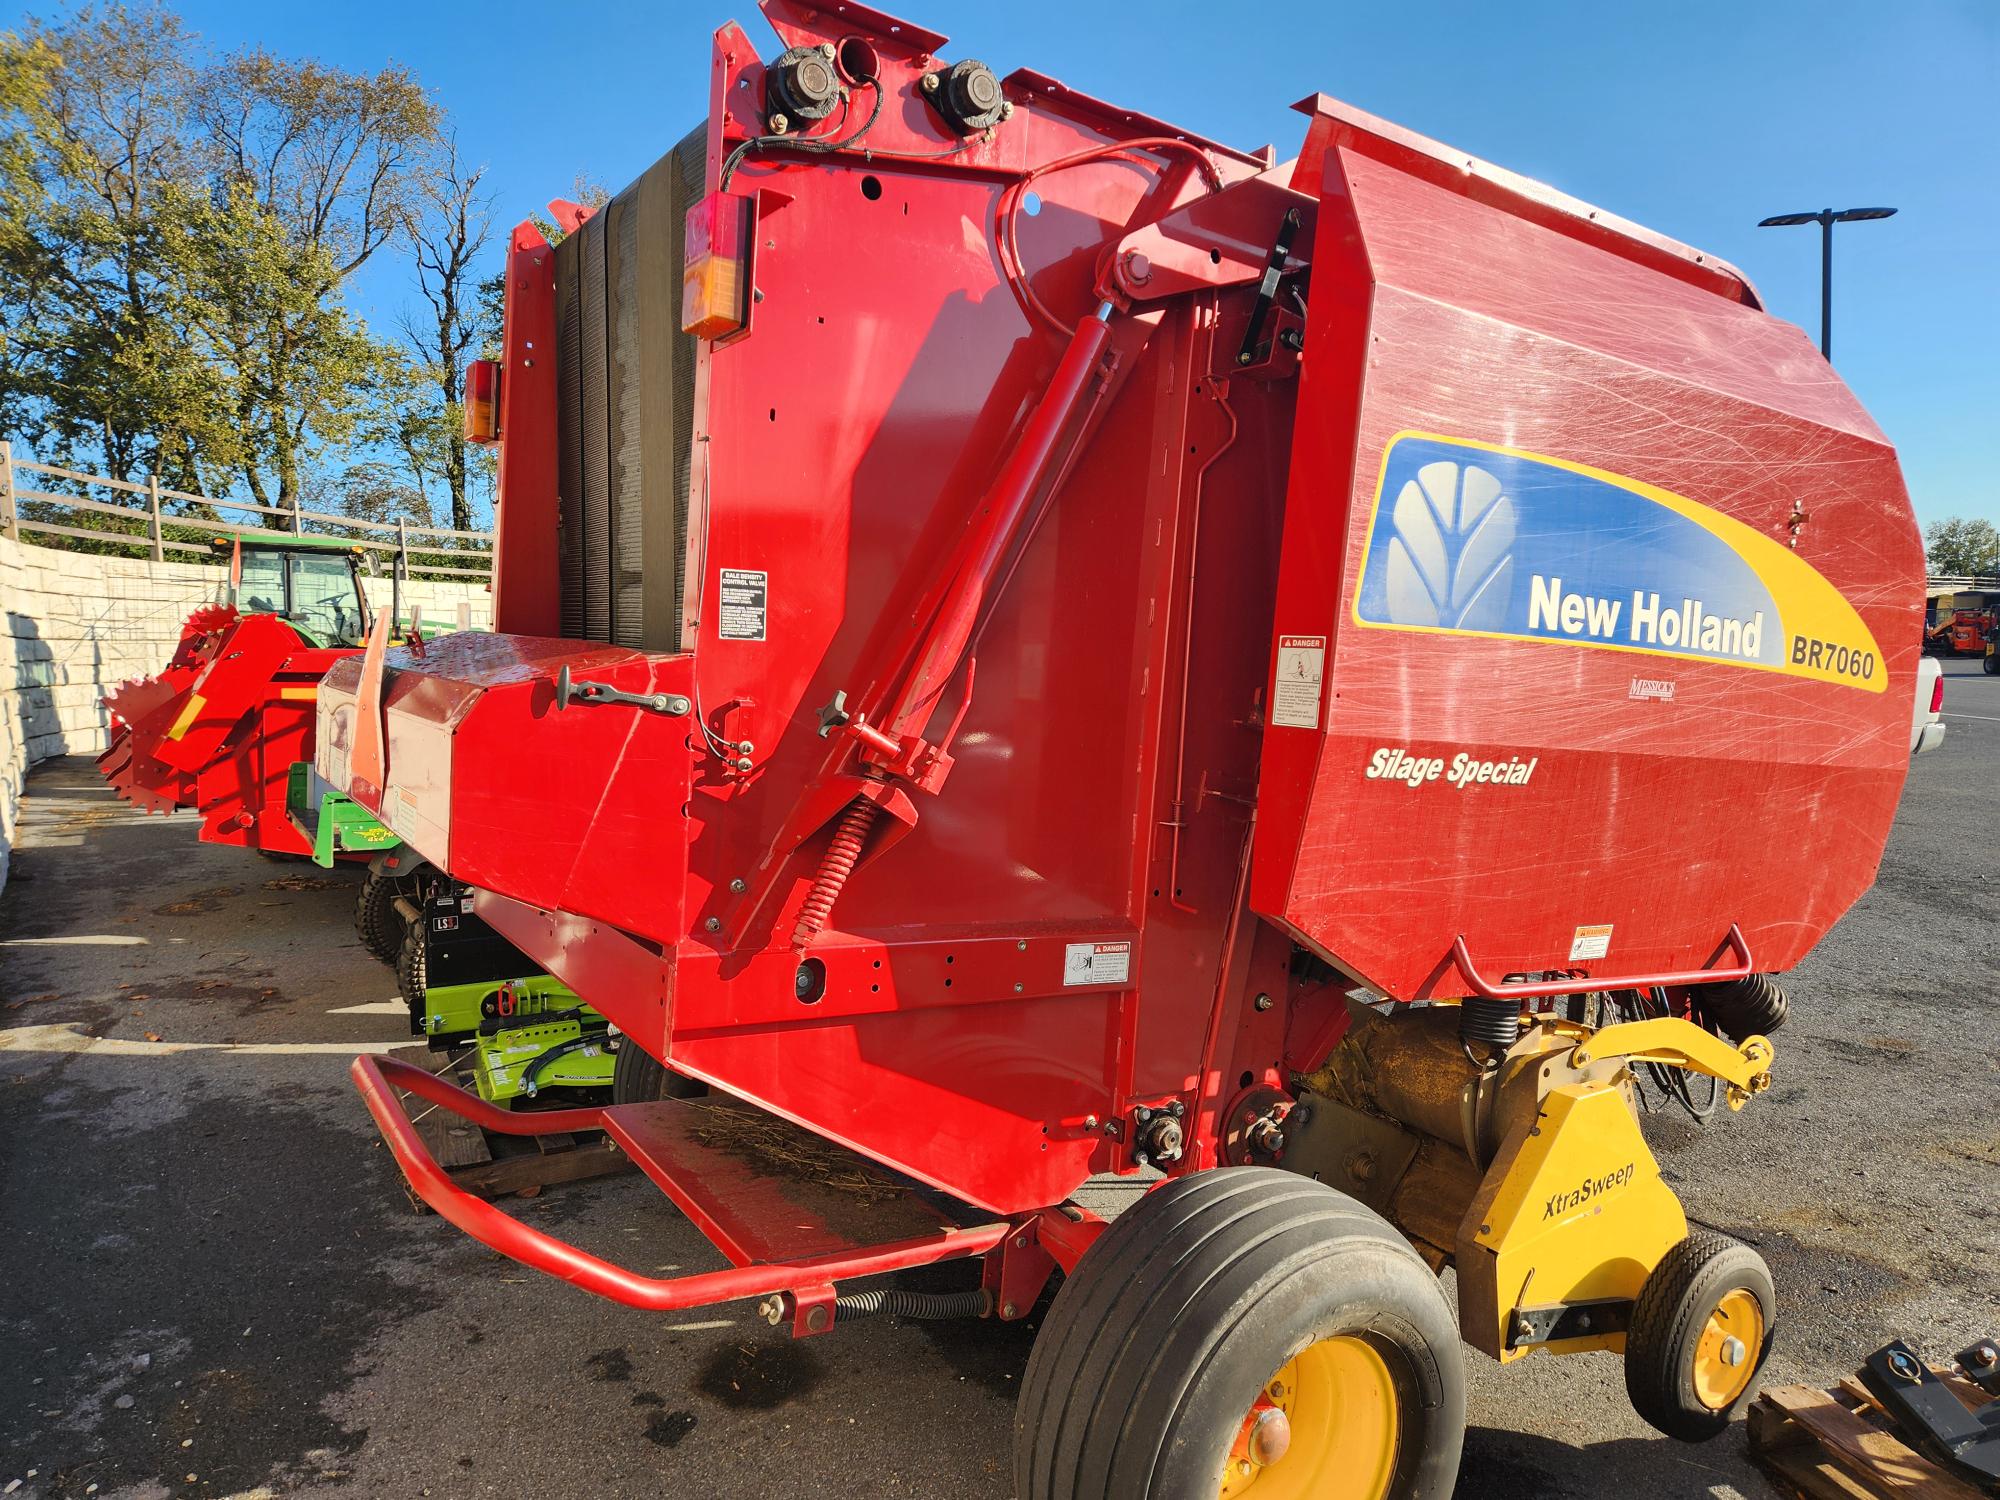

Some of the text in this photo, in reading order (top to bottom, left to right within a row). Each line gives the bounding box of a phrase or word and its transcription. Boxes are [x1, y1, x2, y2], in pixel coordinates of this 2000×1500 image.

[722, 578, 748, 586] CONTROL
[741, 573, 763, 581] DENSITY
[1528, 574, 1764, 658] New Holland
[1292, 639, 1320, 647] DANGER
[1791, 635, 1875, 681] BR7060
[1629, 679, 1676, 695] MESSICK'S
[1366, 748, 1538, 789] Silage Special
[1102, 944, 1128, 953] DANGER
[1543, 1161, 1635, 1221] XtraSweep
